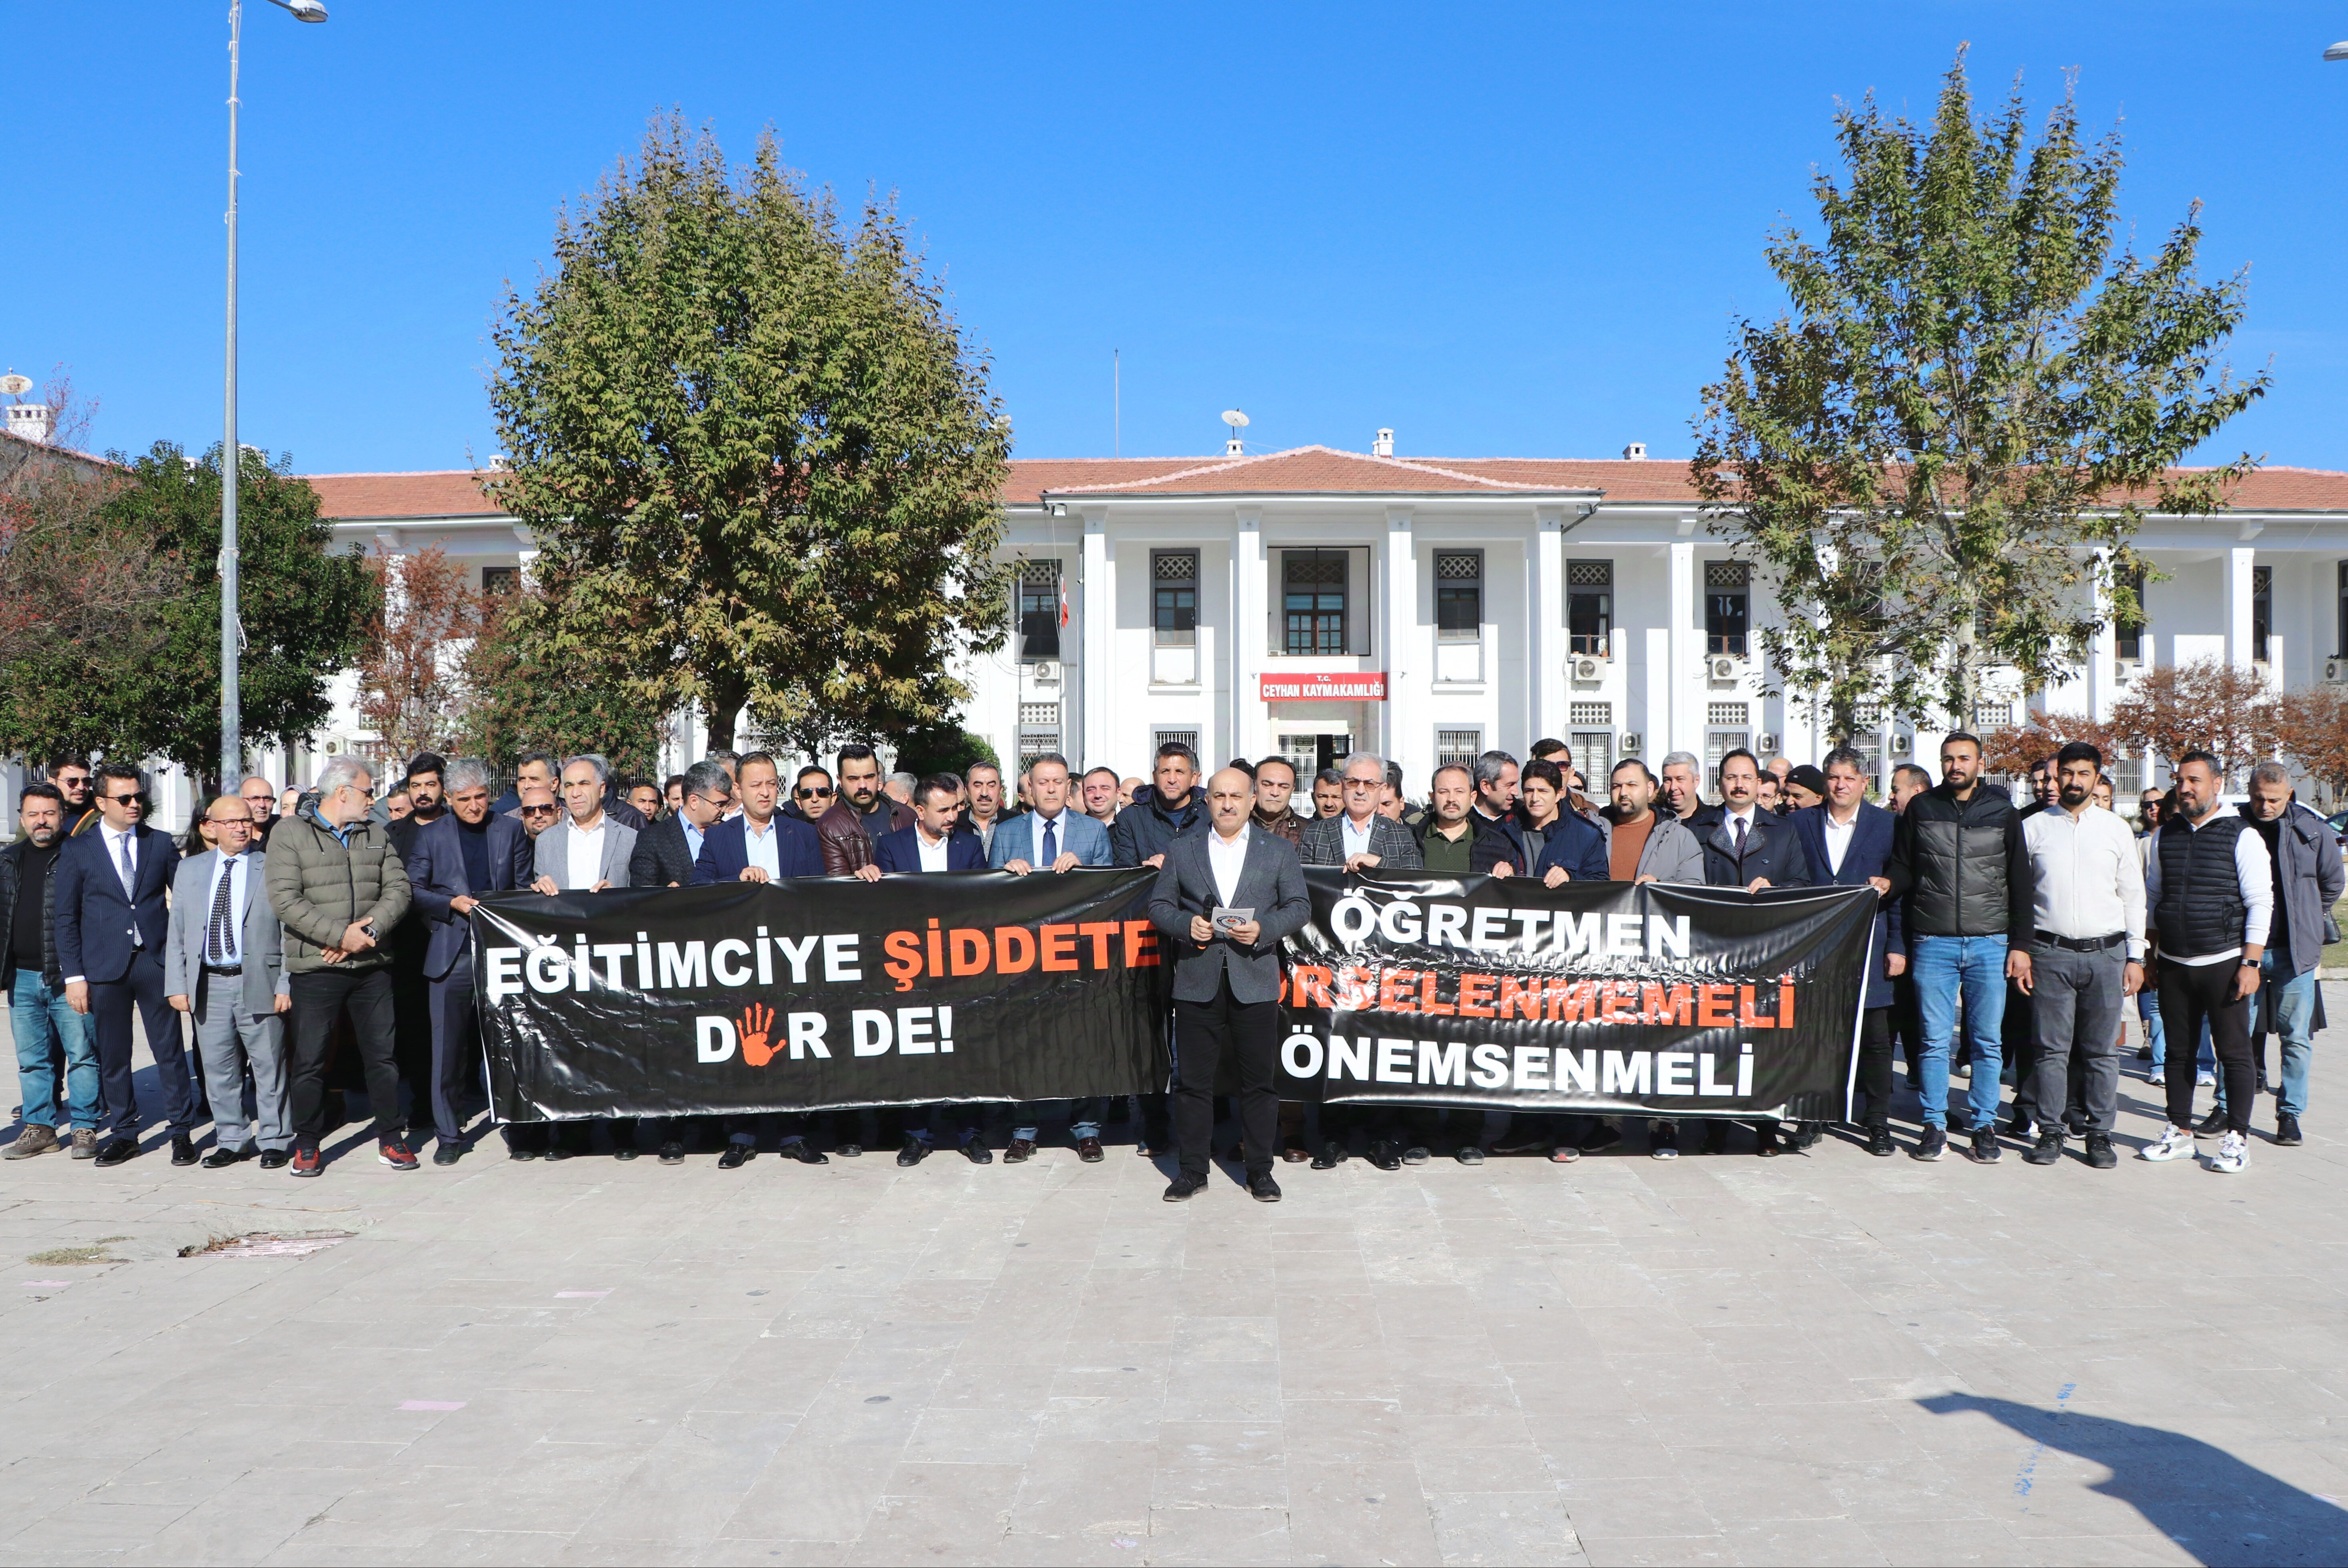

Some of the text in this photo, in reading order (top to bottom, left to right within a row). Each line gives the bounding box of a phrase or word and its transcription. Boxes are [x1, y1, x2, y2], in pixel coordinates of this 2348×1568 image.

[1263, 681, 1384, 697] CEYHAN KAYMAKAMLIĞI
[486, 918, 1161, 995] EĞİTİMCİYE ŞİDDETE
[1330, 888, 1691, 958] ÖĞRETMEN
[1278, 965, 1795, 1029] RSELENMEMELİ
[851, 1005, 954, 1057] DE!
[1281, 1024, 1754, 1097] ÖNEMSENMELİ
